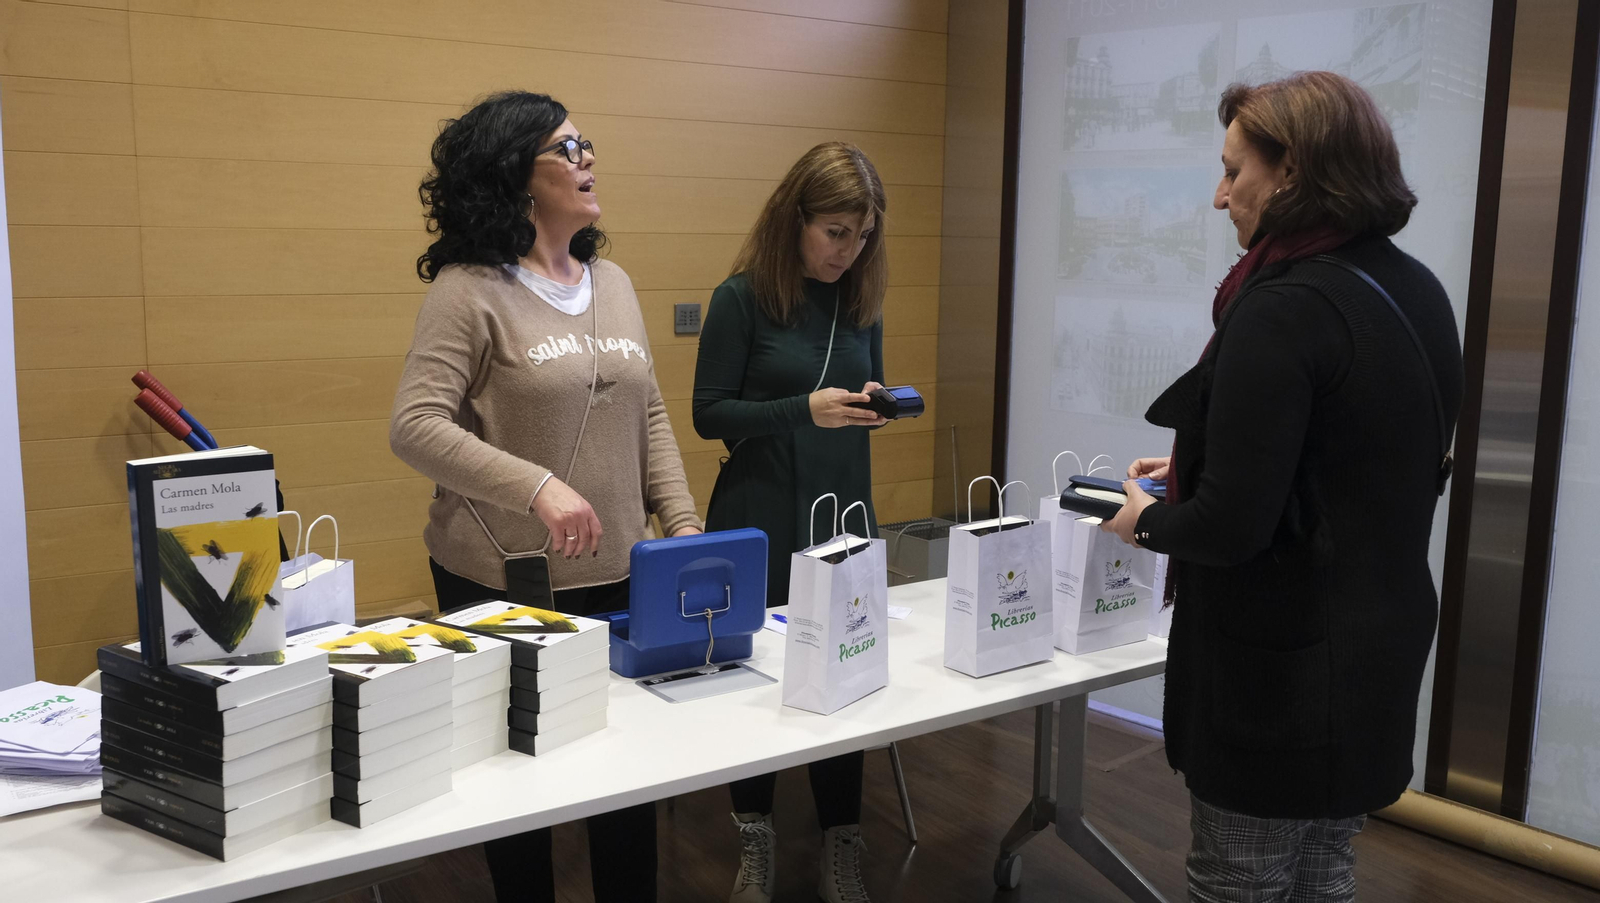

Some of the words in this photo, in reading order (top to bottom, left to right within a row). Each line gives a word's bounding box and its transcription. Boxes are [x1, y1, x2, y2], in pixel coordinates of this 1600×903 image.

[527, 333, 583, 365] saint
[160, 486, 207, 499] Carmen
[211, 482, 242, 495] Mola
[161, 504, 178, 514] Las
[180, 502, 215, 513] madres
[1095, 597, 1137, 614] Picasso
[990, 611, 1037, 631] Picasso
[839, 637, 876, 662] Picasso
[0, 695, 75, 722] Picasso
